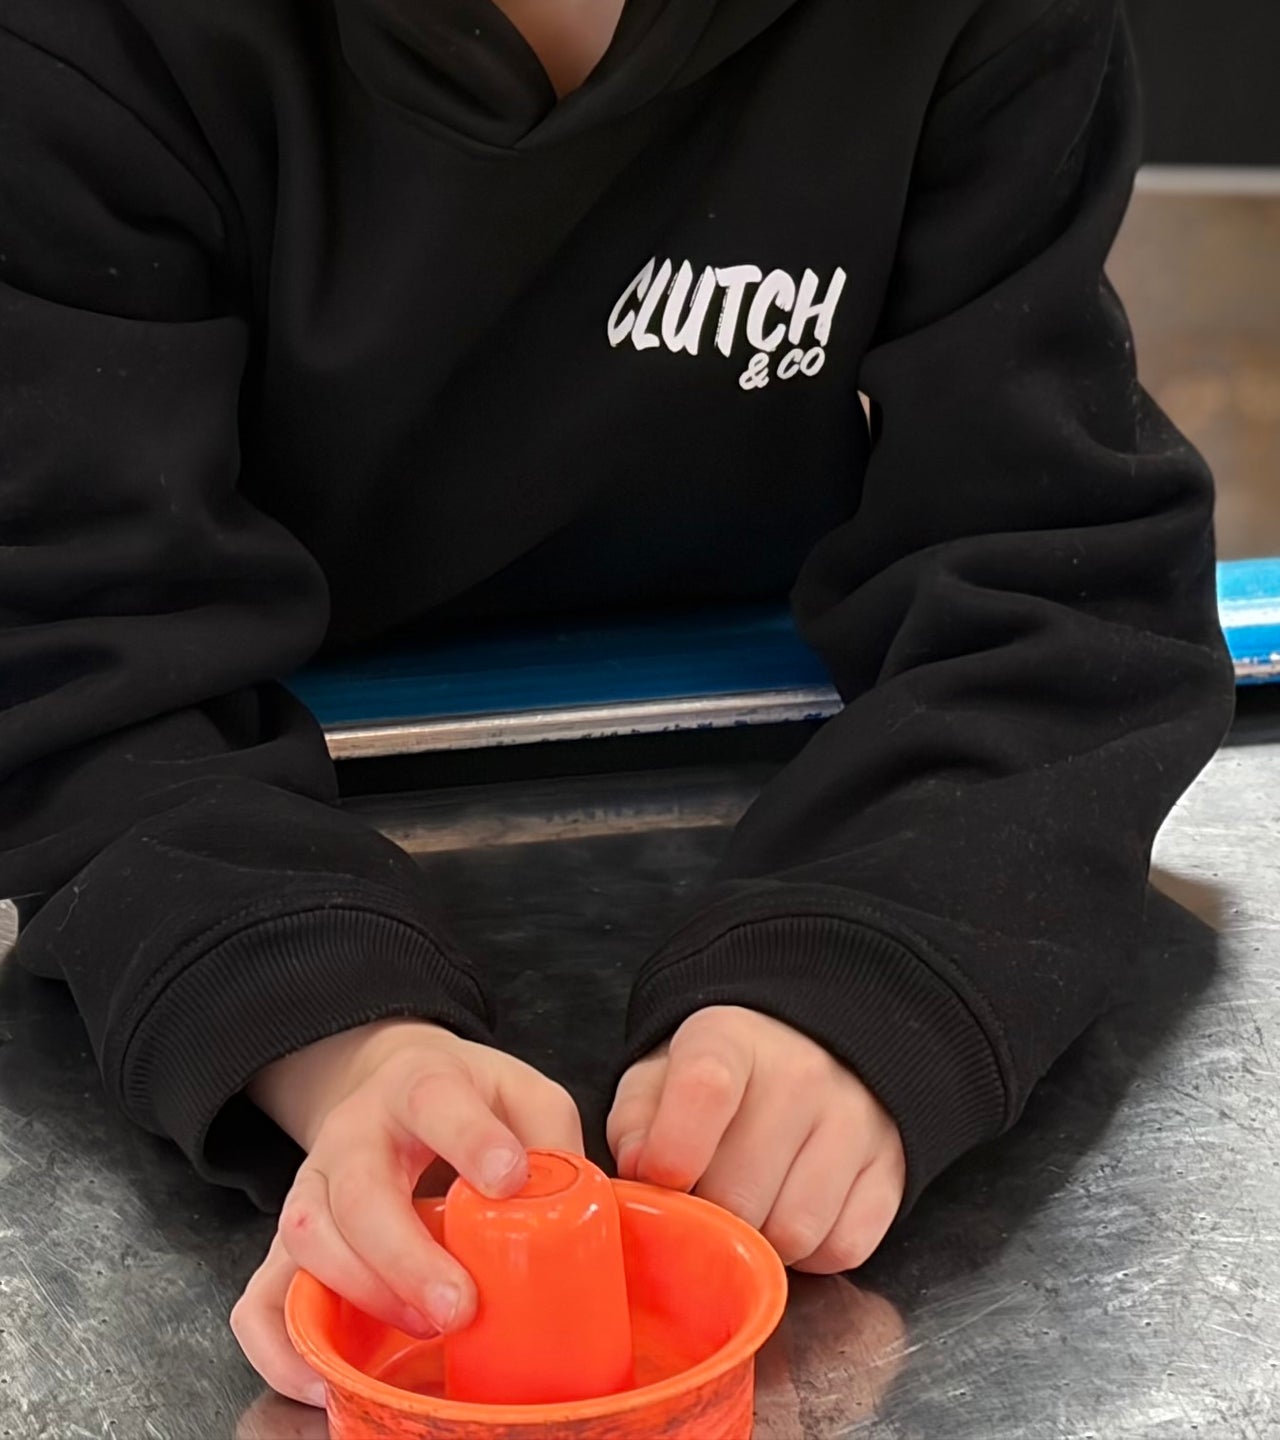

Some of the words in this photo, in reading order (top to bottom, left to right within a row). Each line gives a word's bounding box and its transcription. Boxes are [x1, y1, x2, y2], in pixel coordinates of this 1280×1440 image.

[608, 257, 846, 357] CLUTCH
[739, 352, 769, 390] &
[777, 346, 825, 379] CO
